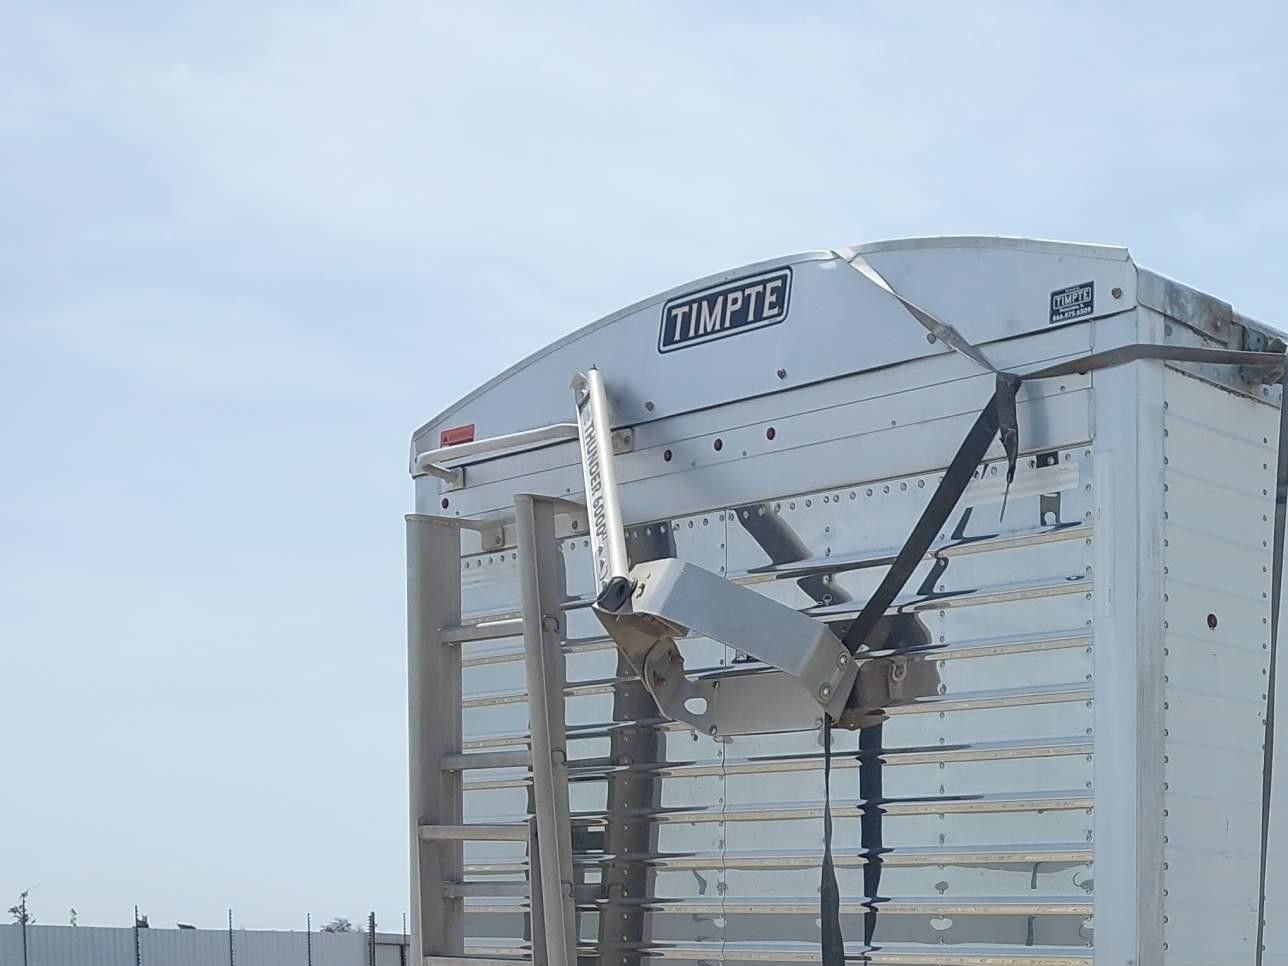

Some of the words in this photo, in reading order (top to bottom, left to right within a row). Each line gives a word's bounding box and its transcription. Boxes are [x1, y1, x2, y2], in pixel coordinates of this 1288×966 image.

[671, 279, 782, 341] TIMPTE
[1056, 290, 1089, 307] TIMPTE
[584, 420, 602, 495] THUNDER
